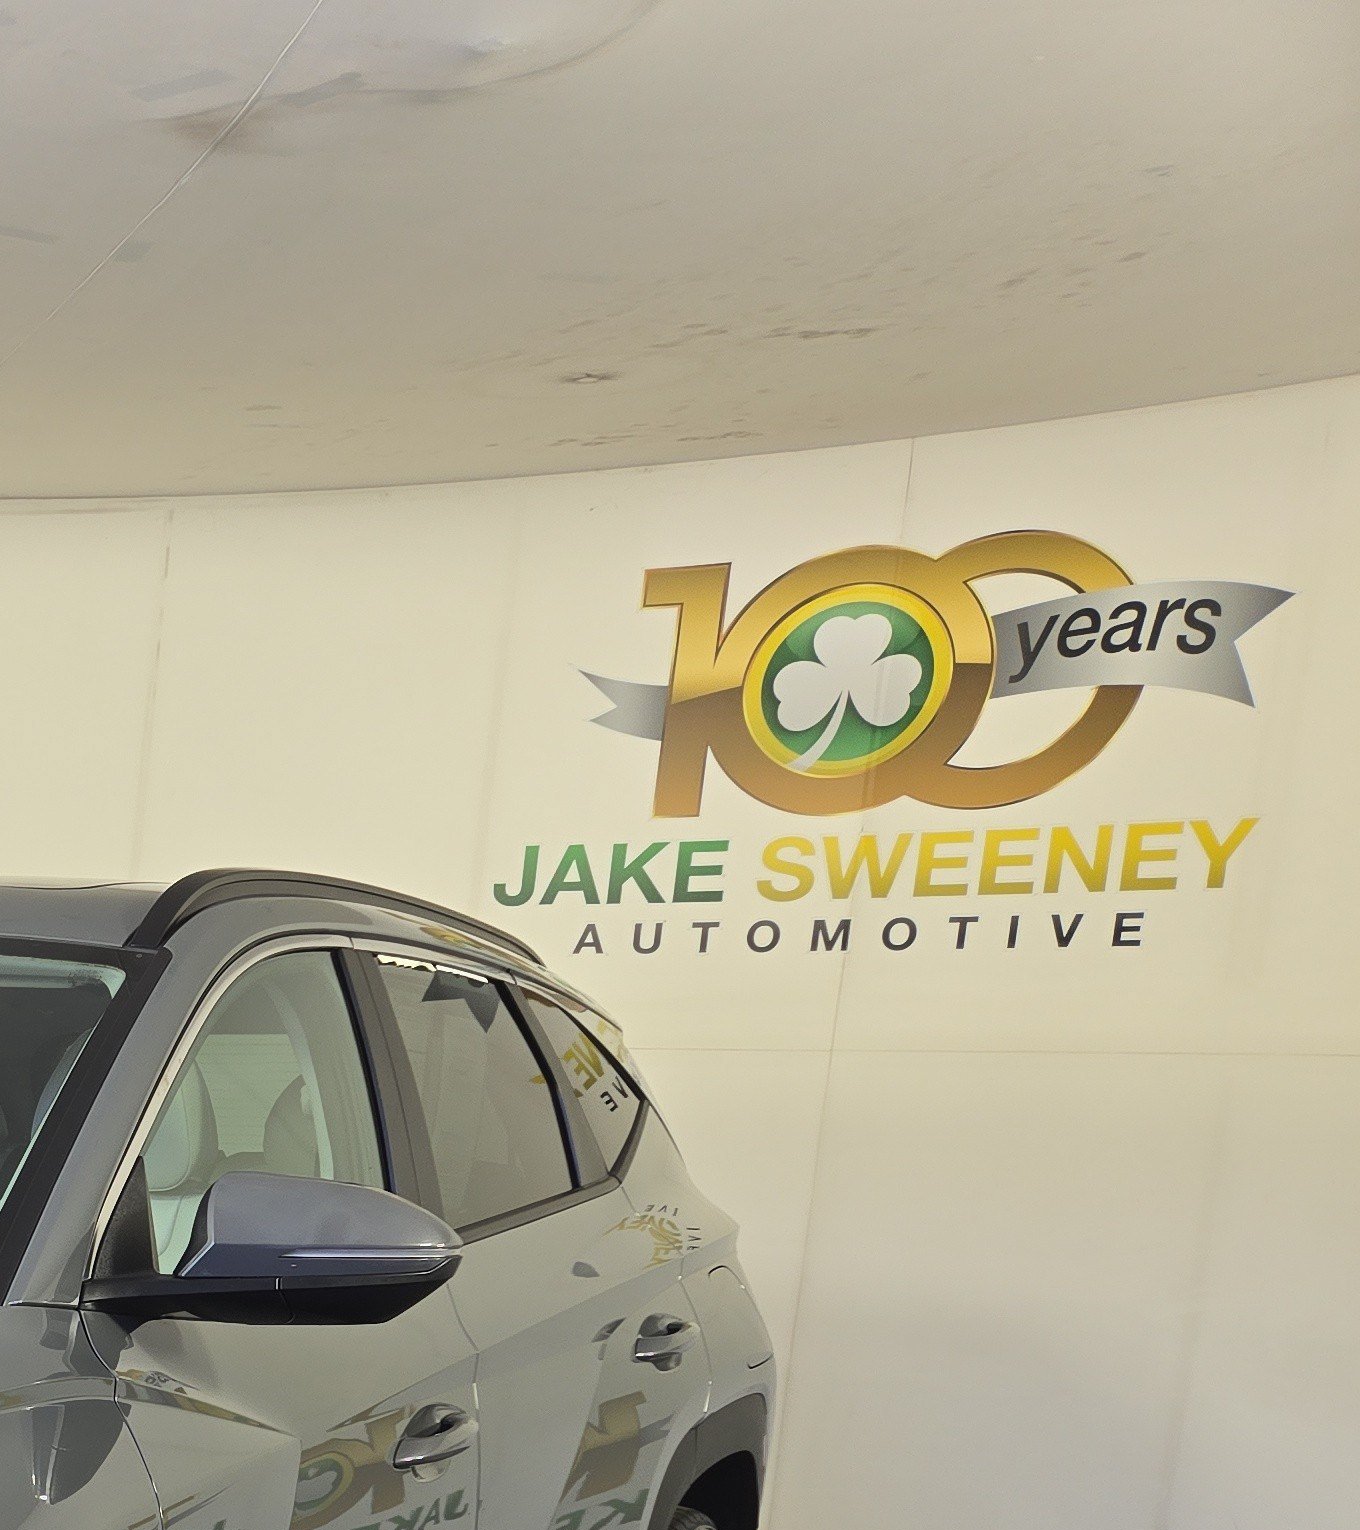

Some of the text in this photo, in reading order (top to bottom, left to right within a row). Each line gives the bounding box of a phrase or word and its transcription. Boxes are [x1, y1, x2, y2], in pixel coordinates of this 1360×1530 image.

[640, 528, 1223, 819] 100 years
[492, 816, 1262, 908] JAKE SWEENEY
[572, 911, 1146, 957] AUTOMOTIVE
